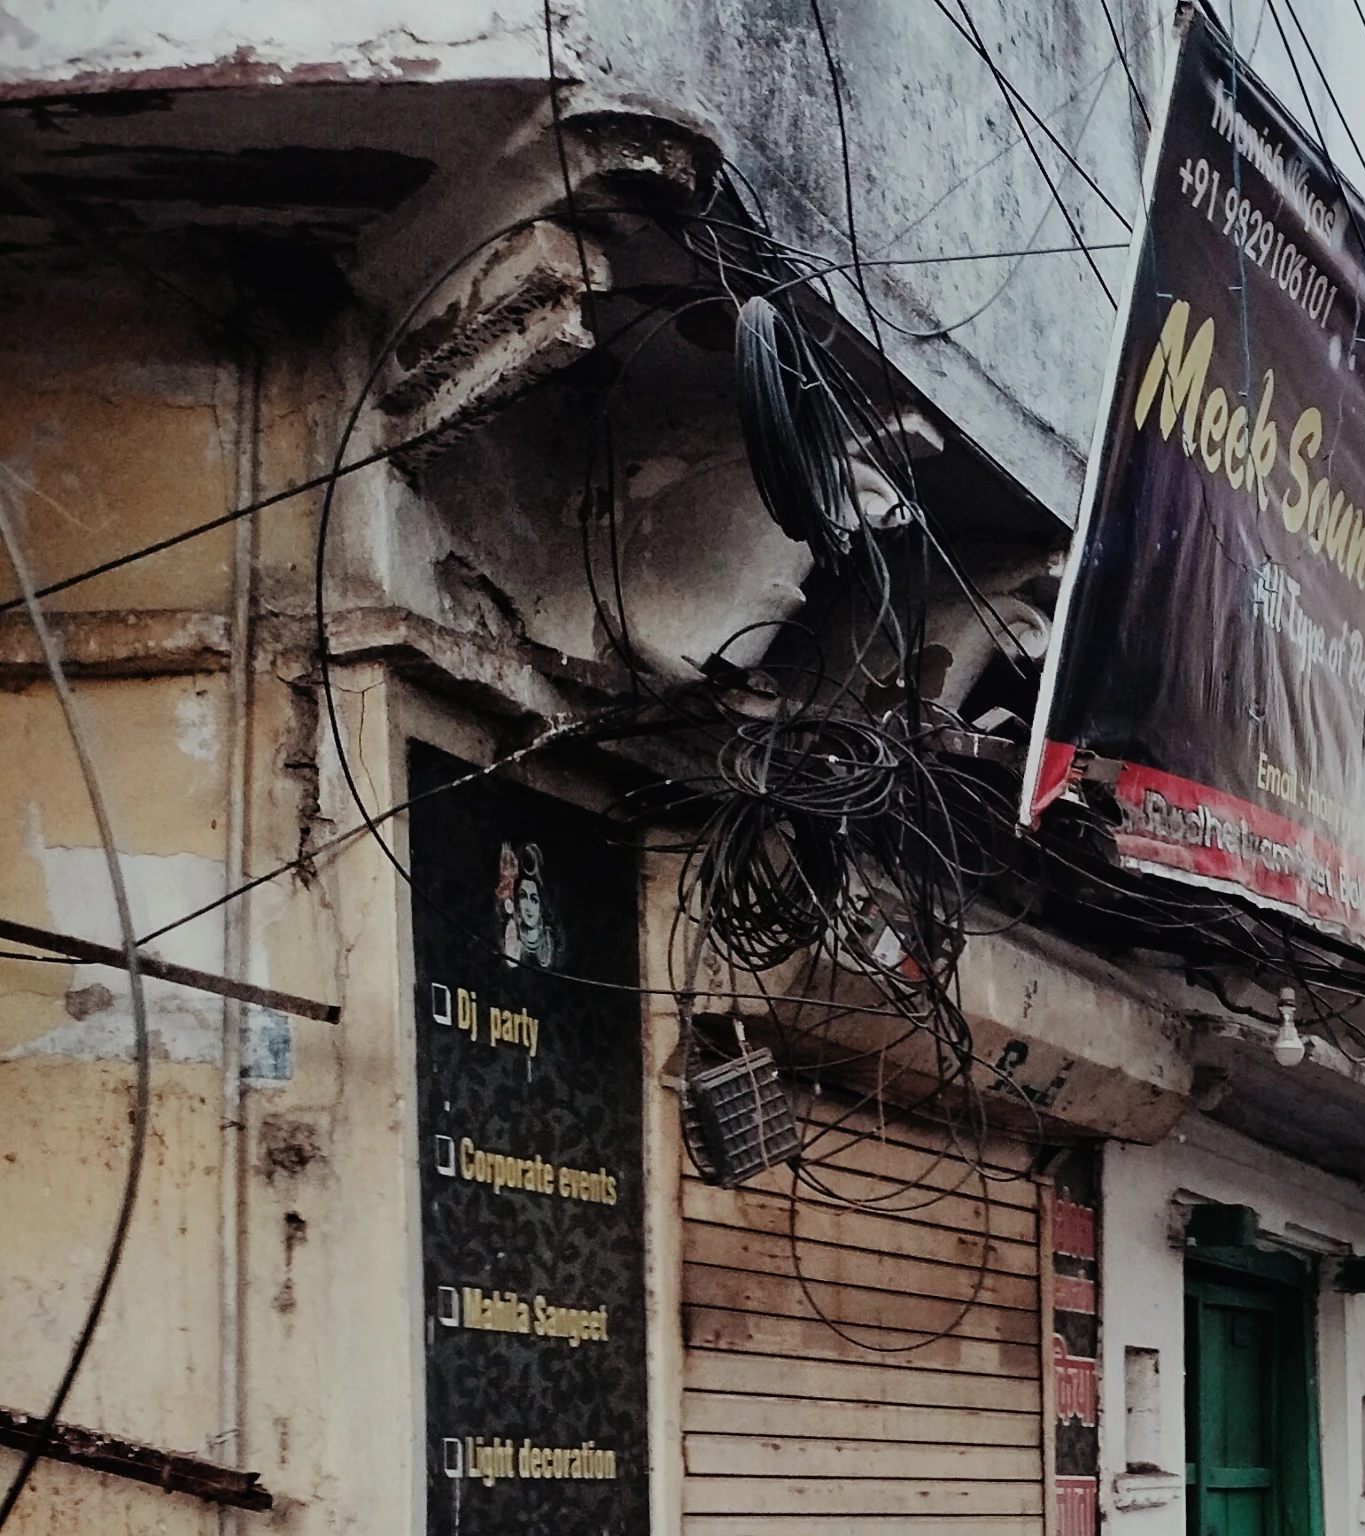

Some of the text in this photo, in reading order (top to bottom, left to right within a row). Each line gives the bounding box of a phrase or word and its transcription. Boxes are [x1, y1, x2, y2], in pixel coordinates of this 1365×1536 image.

[1178, 158, 1338, 329] +91 9829106101
[1134, 299, 1278, 512] Meek
[1286, 575, 1326, 680] Type
[1328, 620, 1349, 677] of
[1256, 751, 1298, 805] Email
[457, 987, 539, 1057] Dj party
[460, 1137, 617, 1205] Corporate events
[463, 1287, 608, 1347] Mahila Sangeet
[465, 1436, 617, 1487] Light decoration
